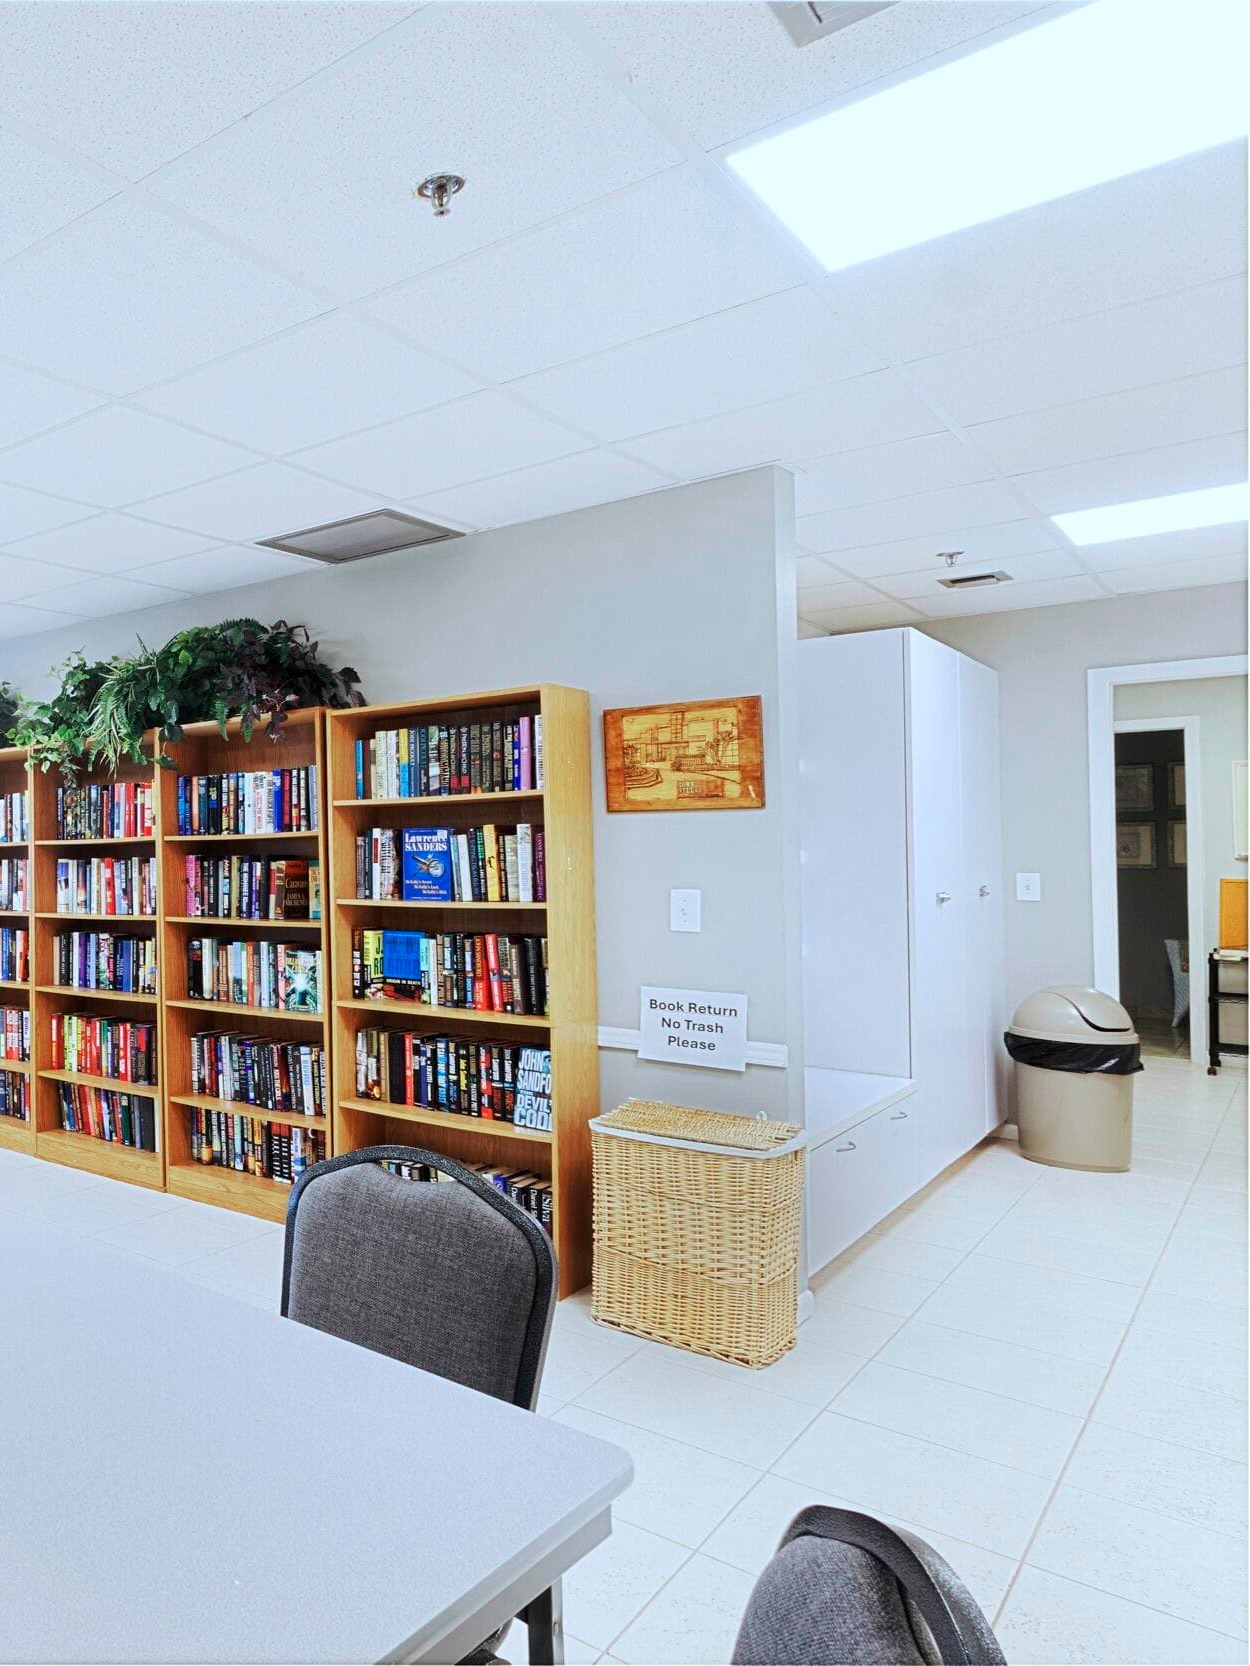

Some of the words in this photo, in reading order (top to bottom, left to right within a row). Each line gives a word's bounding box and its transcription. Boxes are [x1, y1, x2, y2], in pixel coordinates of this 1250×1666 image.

[405, 842, 447, 852] SANDERS
[649, 998, 685, 1013] Book
[688, 1002, 738, 1017] Return
[661, 1017, 681, 1029] No
[684, 1019, 724, 1034] Trash
[667, 1035, 716, 1051] Please
[518, 1048, 543, 1072] JOHN
[516, 1069, 552, 1095] SANDFO
[516, 1093, 552, 1113] DEVIL'
[530, 1189, 538, 1209] Daniel
